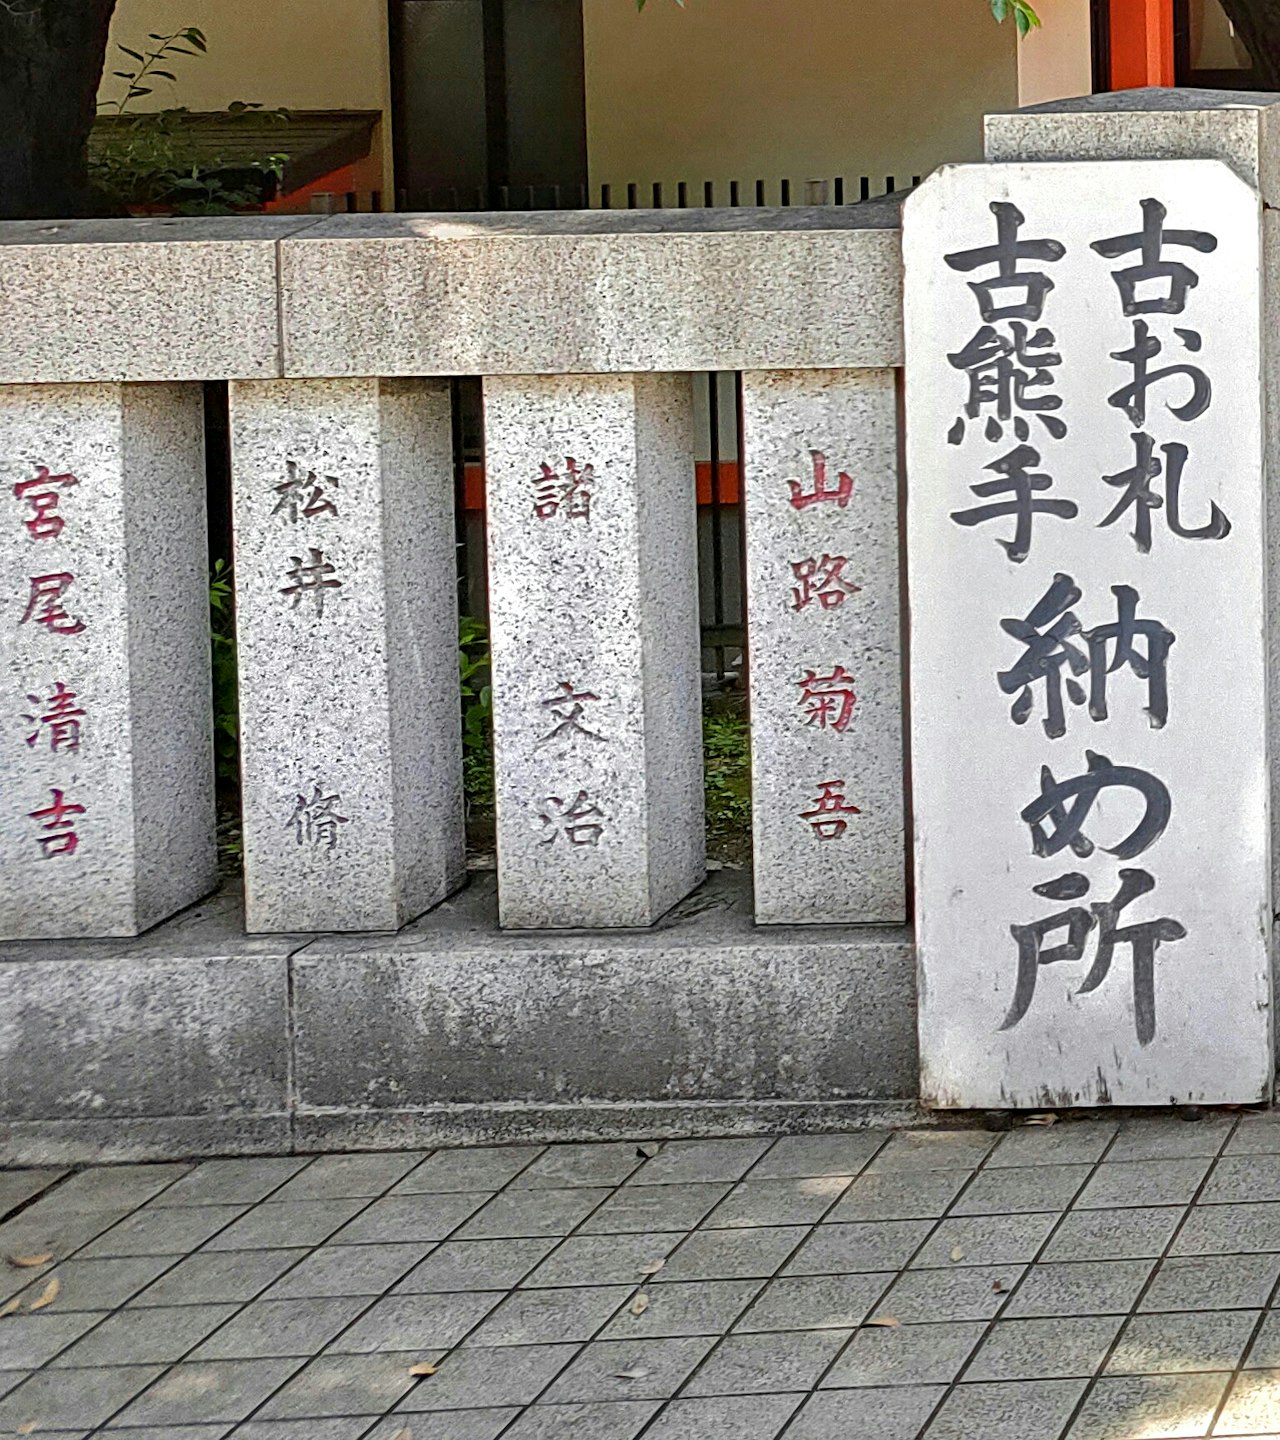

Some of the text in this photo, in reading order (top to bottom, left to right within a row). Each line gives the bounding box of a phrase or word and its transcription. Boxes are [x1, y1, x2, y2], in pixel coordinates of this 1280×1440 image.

[944, 200, 1079, 563] 古熊手
[1089, 197, 1233, 555] 古お札
[12, 464, 87, 861] 宮尾清吉
[529, 456, 610, 850] 諸文治
[787, 448, 862, 841] 山路菊吾
[999, 572, 1188, 1046] 納め所
